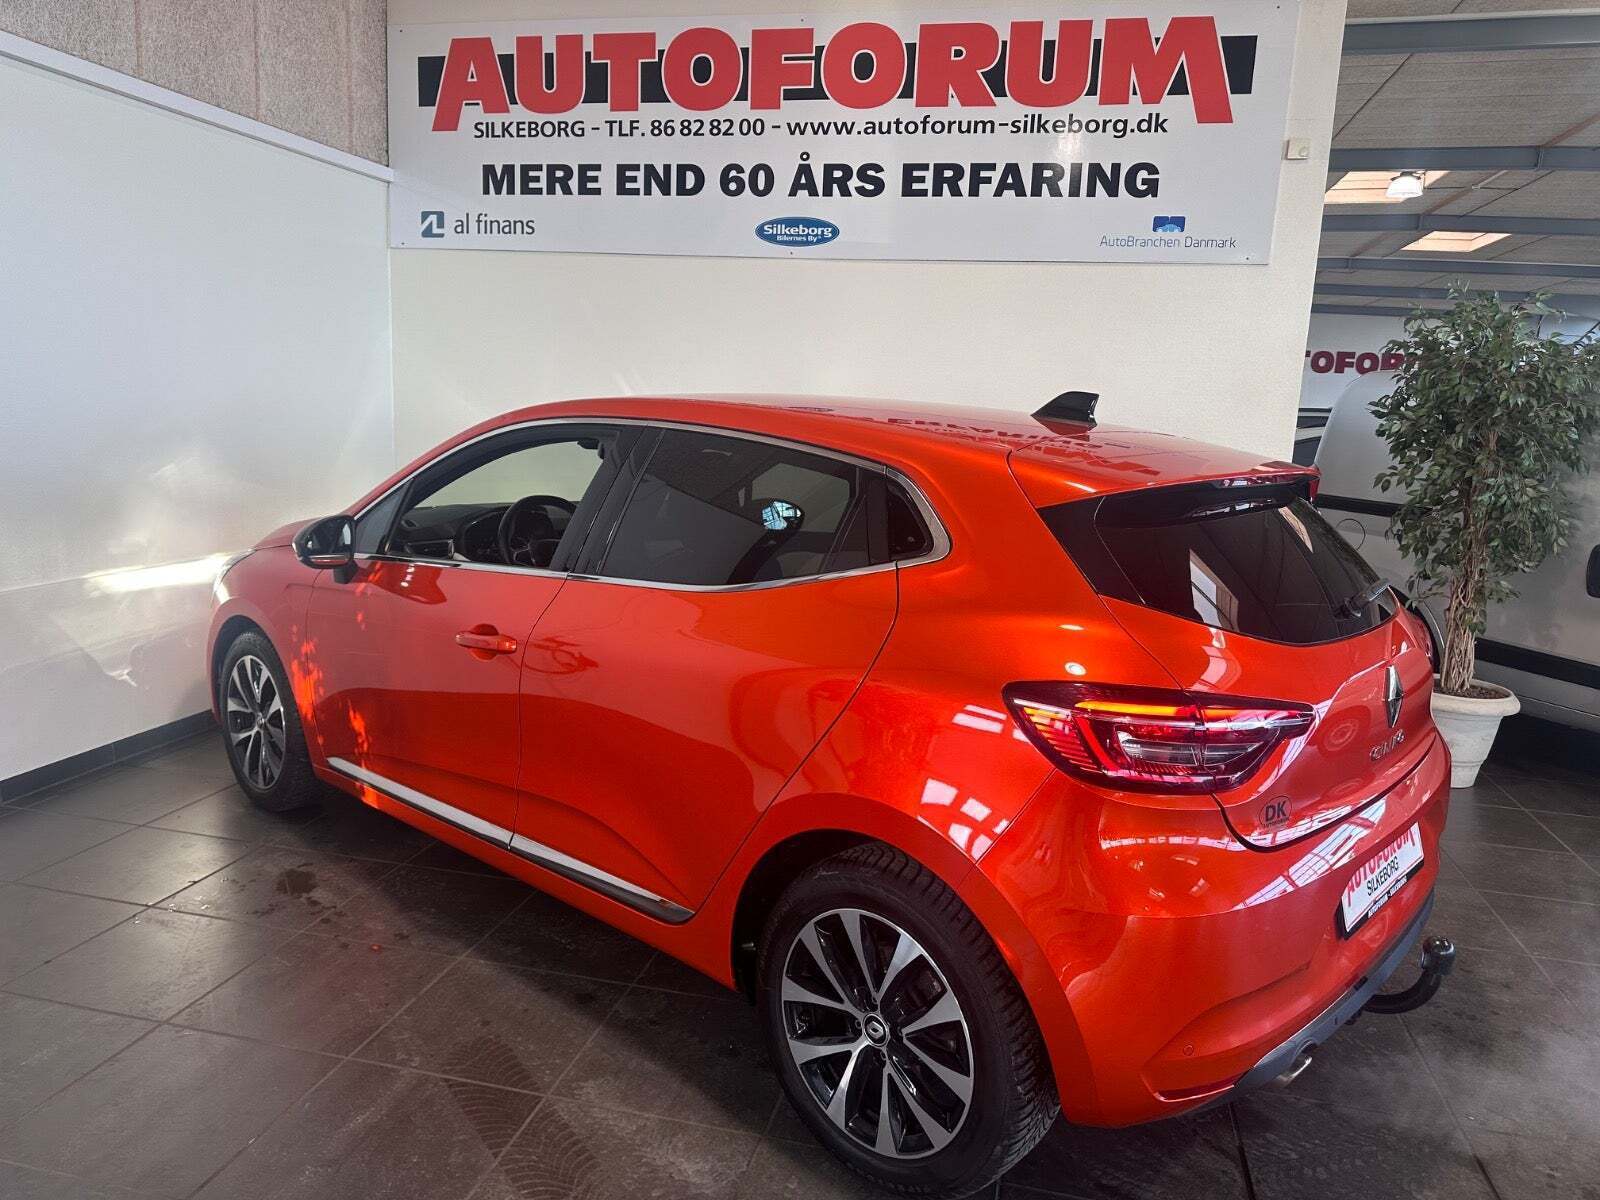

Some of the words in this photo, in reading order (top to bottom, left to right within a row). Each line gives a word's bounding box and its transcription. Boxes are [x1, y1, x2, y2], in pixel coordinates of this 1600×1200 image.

[432, 16, 1233, 132] AUTOFORUM
[473, 120, 585, 139] SILKEBORG
[605, 120, 646, 137] TLF.
[650, 119, 676, 137] 86
[679, 118, 705, 137] 82
[708, 118, 735, 137] 82
[738, 118, 765, 137] 00
[786, 113, 1169, 139] www.autoforum-silkeborg.dk
[482, 163, 602, 196] MERE
[616, 163, 706, 197] END
[719, 163, 775, 198] 60
[788, 151, 886, 198] ÅRS
[901, 162, 1160, 199] ERFARING
[453, 212, 470, 235] al
[475, 212, 536, 236] finans
[763, 224, 833, 238] Silkeborg
[1099, 235, 1180, 248] AutoBranchen
[1184, 236, 1237, 248] Danmark
[1265, 800, 1287, 821] DK
[1366, 856, 1400, 896] SILKEBORG
